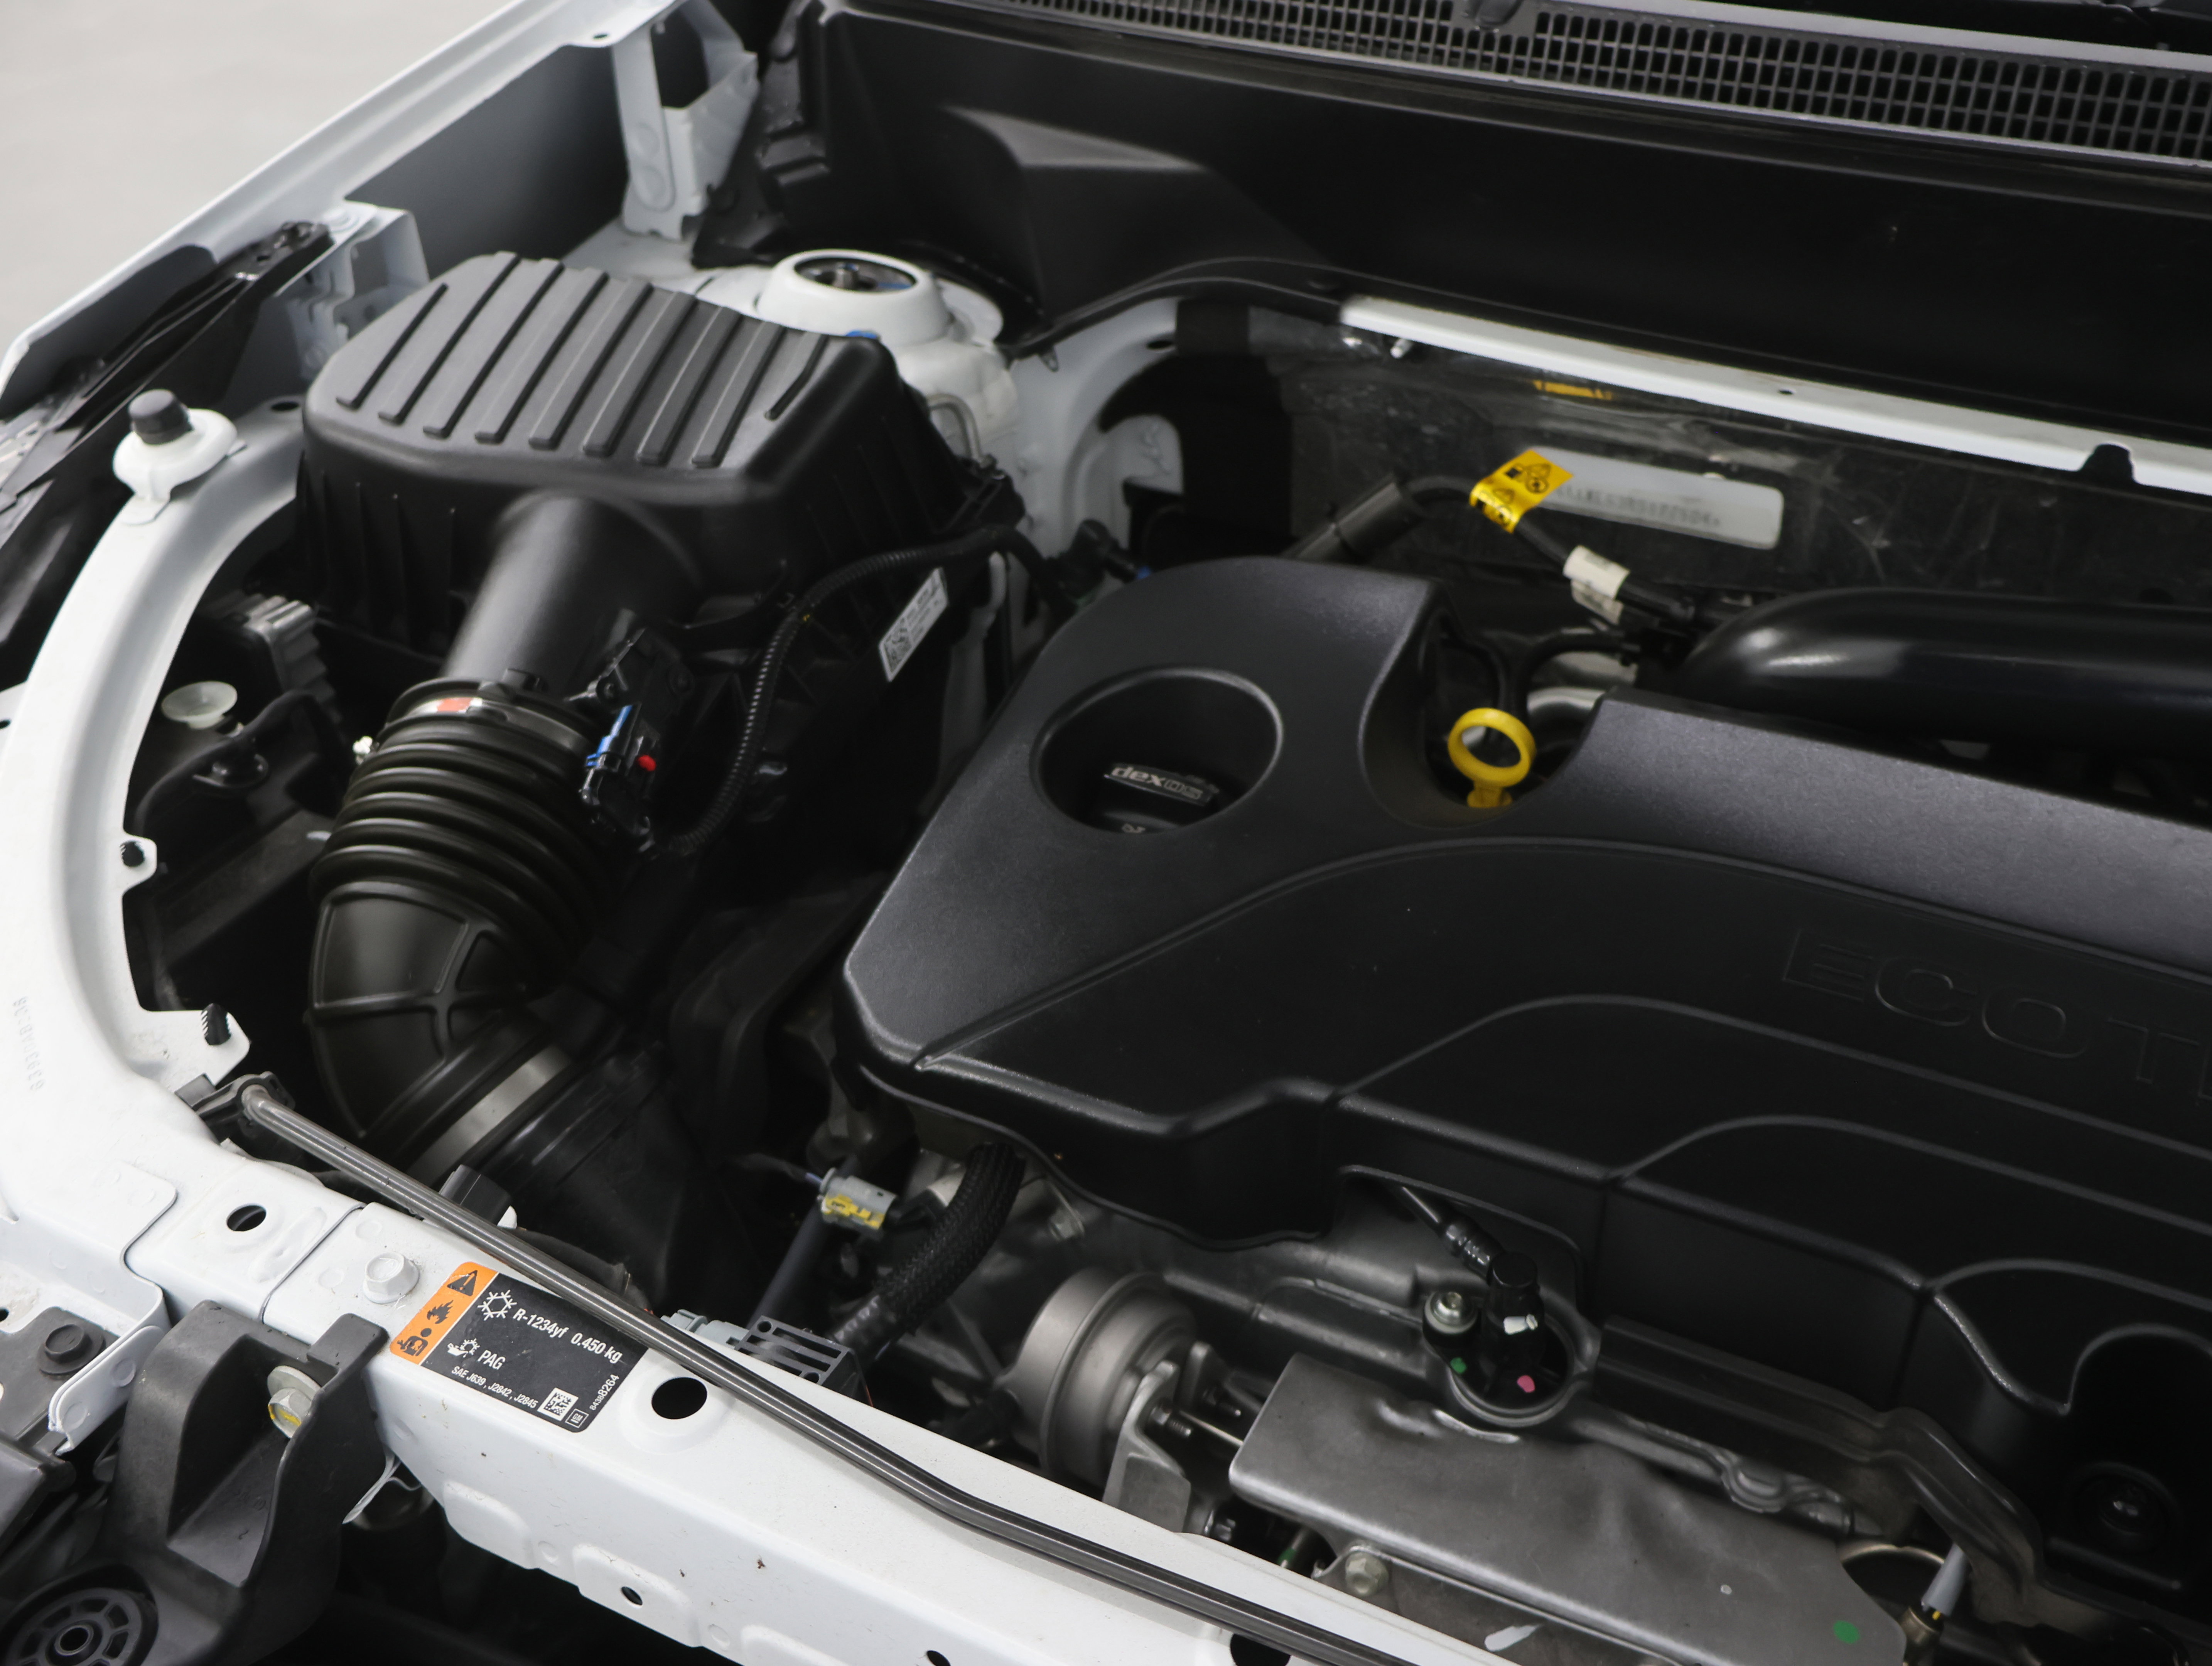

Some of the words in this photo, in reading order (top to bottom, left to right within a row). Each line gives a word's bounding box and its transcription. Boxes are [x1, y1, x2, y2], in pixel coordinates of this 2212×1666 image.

[1781, 927, 2212, 1101] ECOT
[513, 1308, 569, 1338] R-1234yf
[570, 1333, 606, 1354] 0.450
[604, 1346, 623, 1364] kg
[477, 1350, 506, 1370] PAG
[451, 1366, 469, 1378] SAE
[514, 1393, 538, 1408] J2845
[589, 1374, 619, 1410] 84388264
